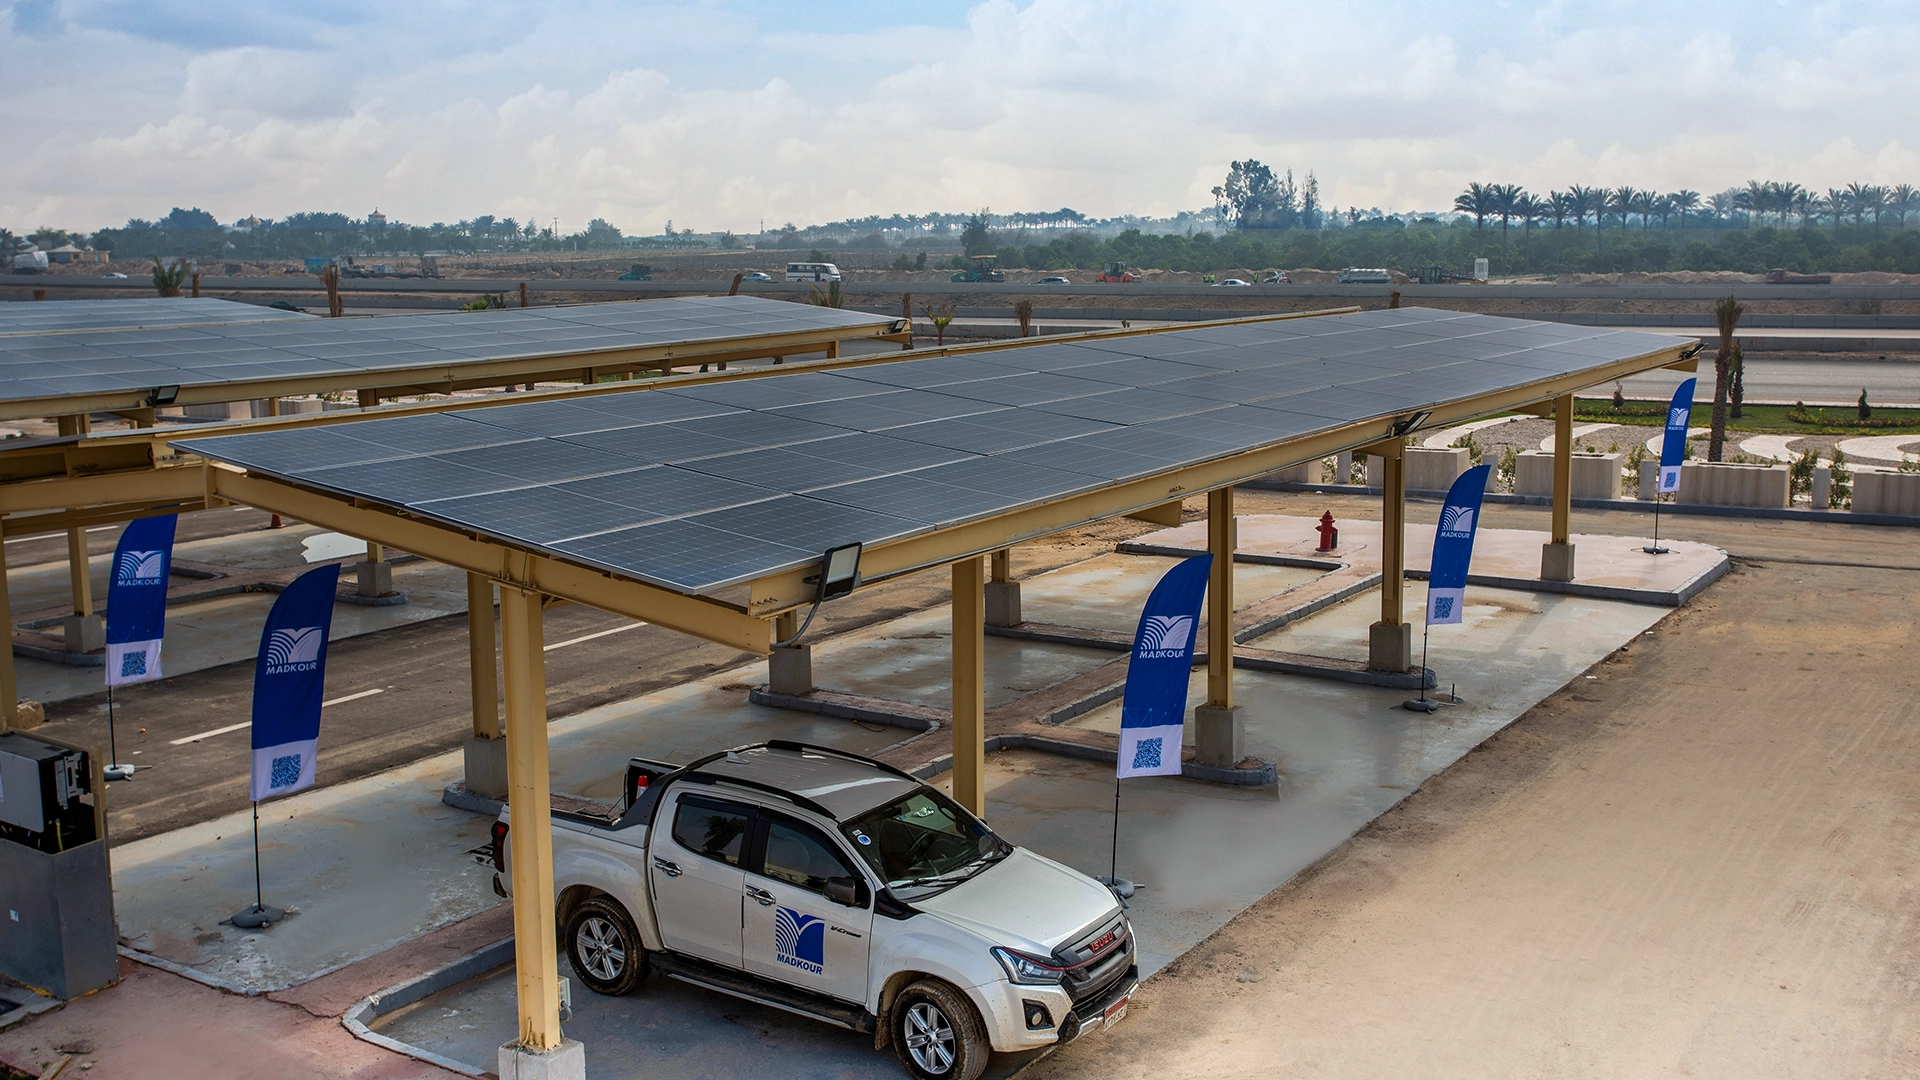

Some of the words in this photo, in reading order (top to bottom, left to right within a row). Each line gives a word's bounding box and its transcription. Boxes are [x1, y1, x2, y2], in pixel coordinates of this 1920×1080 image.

[1440, 531, 1471, 539] MADKOUR
[1139, 649, 1185, 659] MADKOUR
[266, 661, 317, 675] MADKOUR
[1091, 931, 1114, 953] ISUZU
[776, 953, 823, 975] MADKOUR
